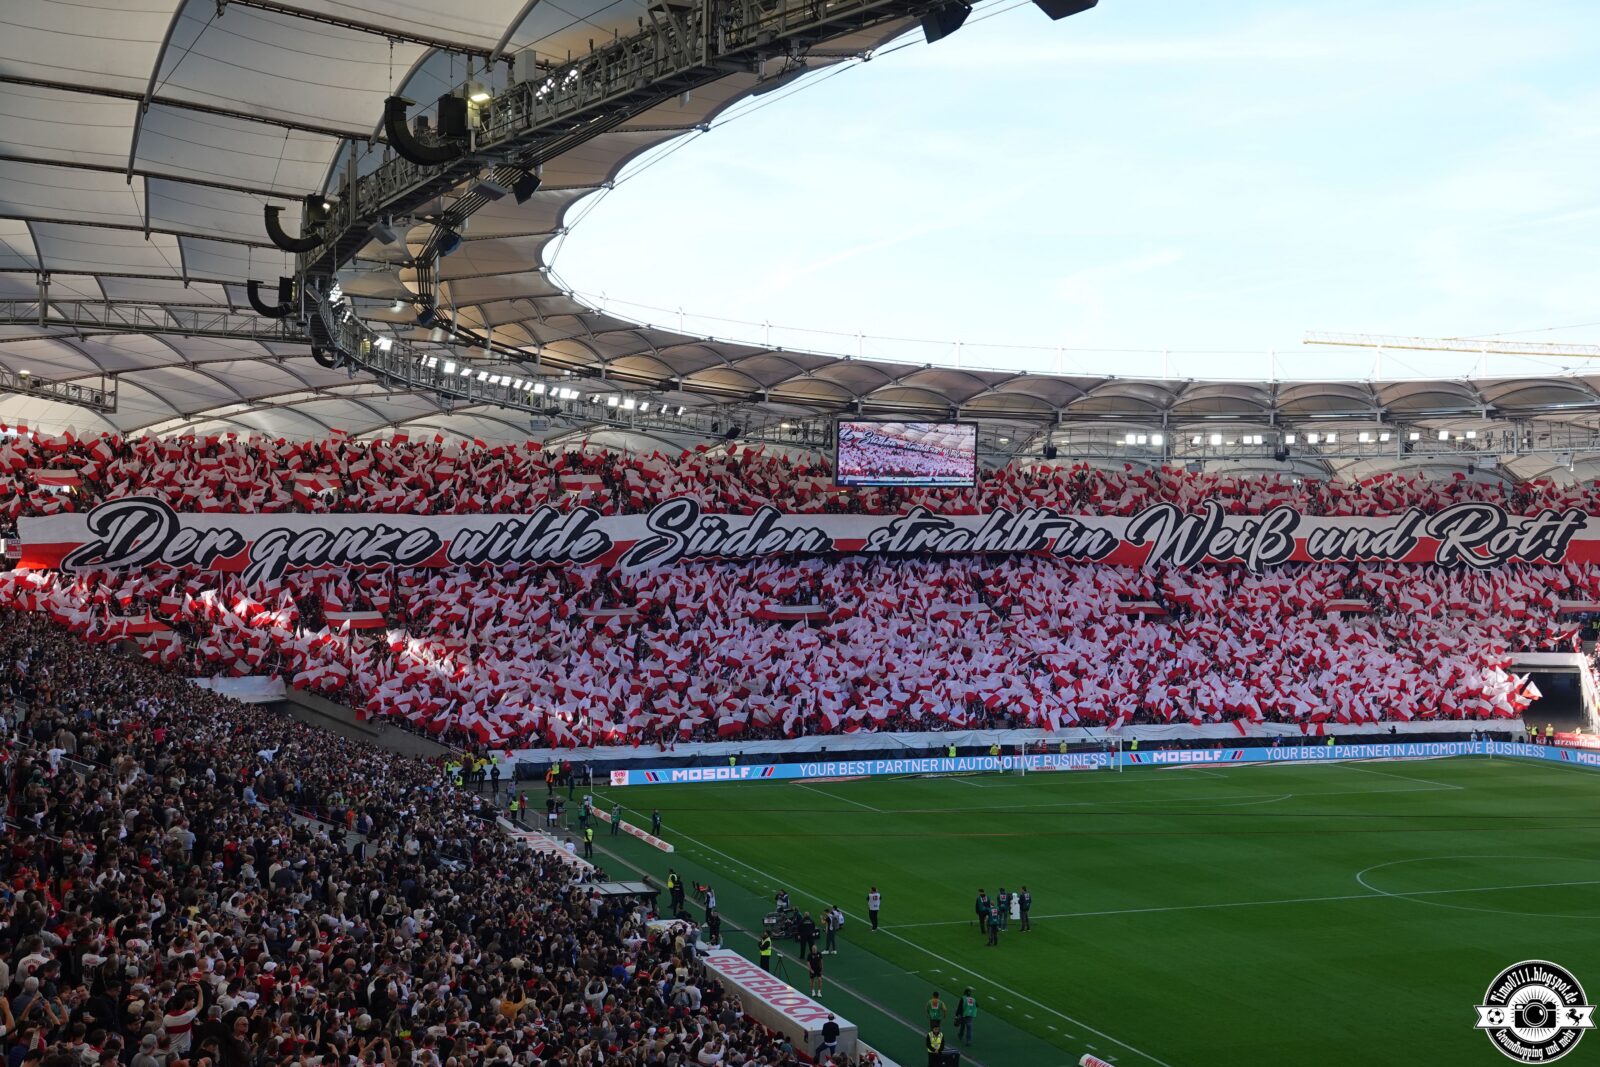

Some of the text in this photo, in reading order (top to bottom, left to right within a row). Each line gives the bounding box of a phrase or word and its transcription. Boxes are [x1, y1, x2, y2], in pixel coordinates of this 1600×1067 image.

[61, 495, 1588, 584] Der ganze wilde Süden strahlt in Weiß und Rot!
[1153, 751, 1222, 763] MOSOLF
[1265, 740, 1545, 760] YOUR BEST PARTNER IN AUTOMOTIVE BUSINESS
[672, 766, 751, 782] MOSOLF
[799, 752, 1107, 777] YOUR BEST PARTNER IN AUTOMOTIVE BUSINESS
